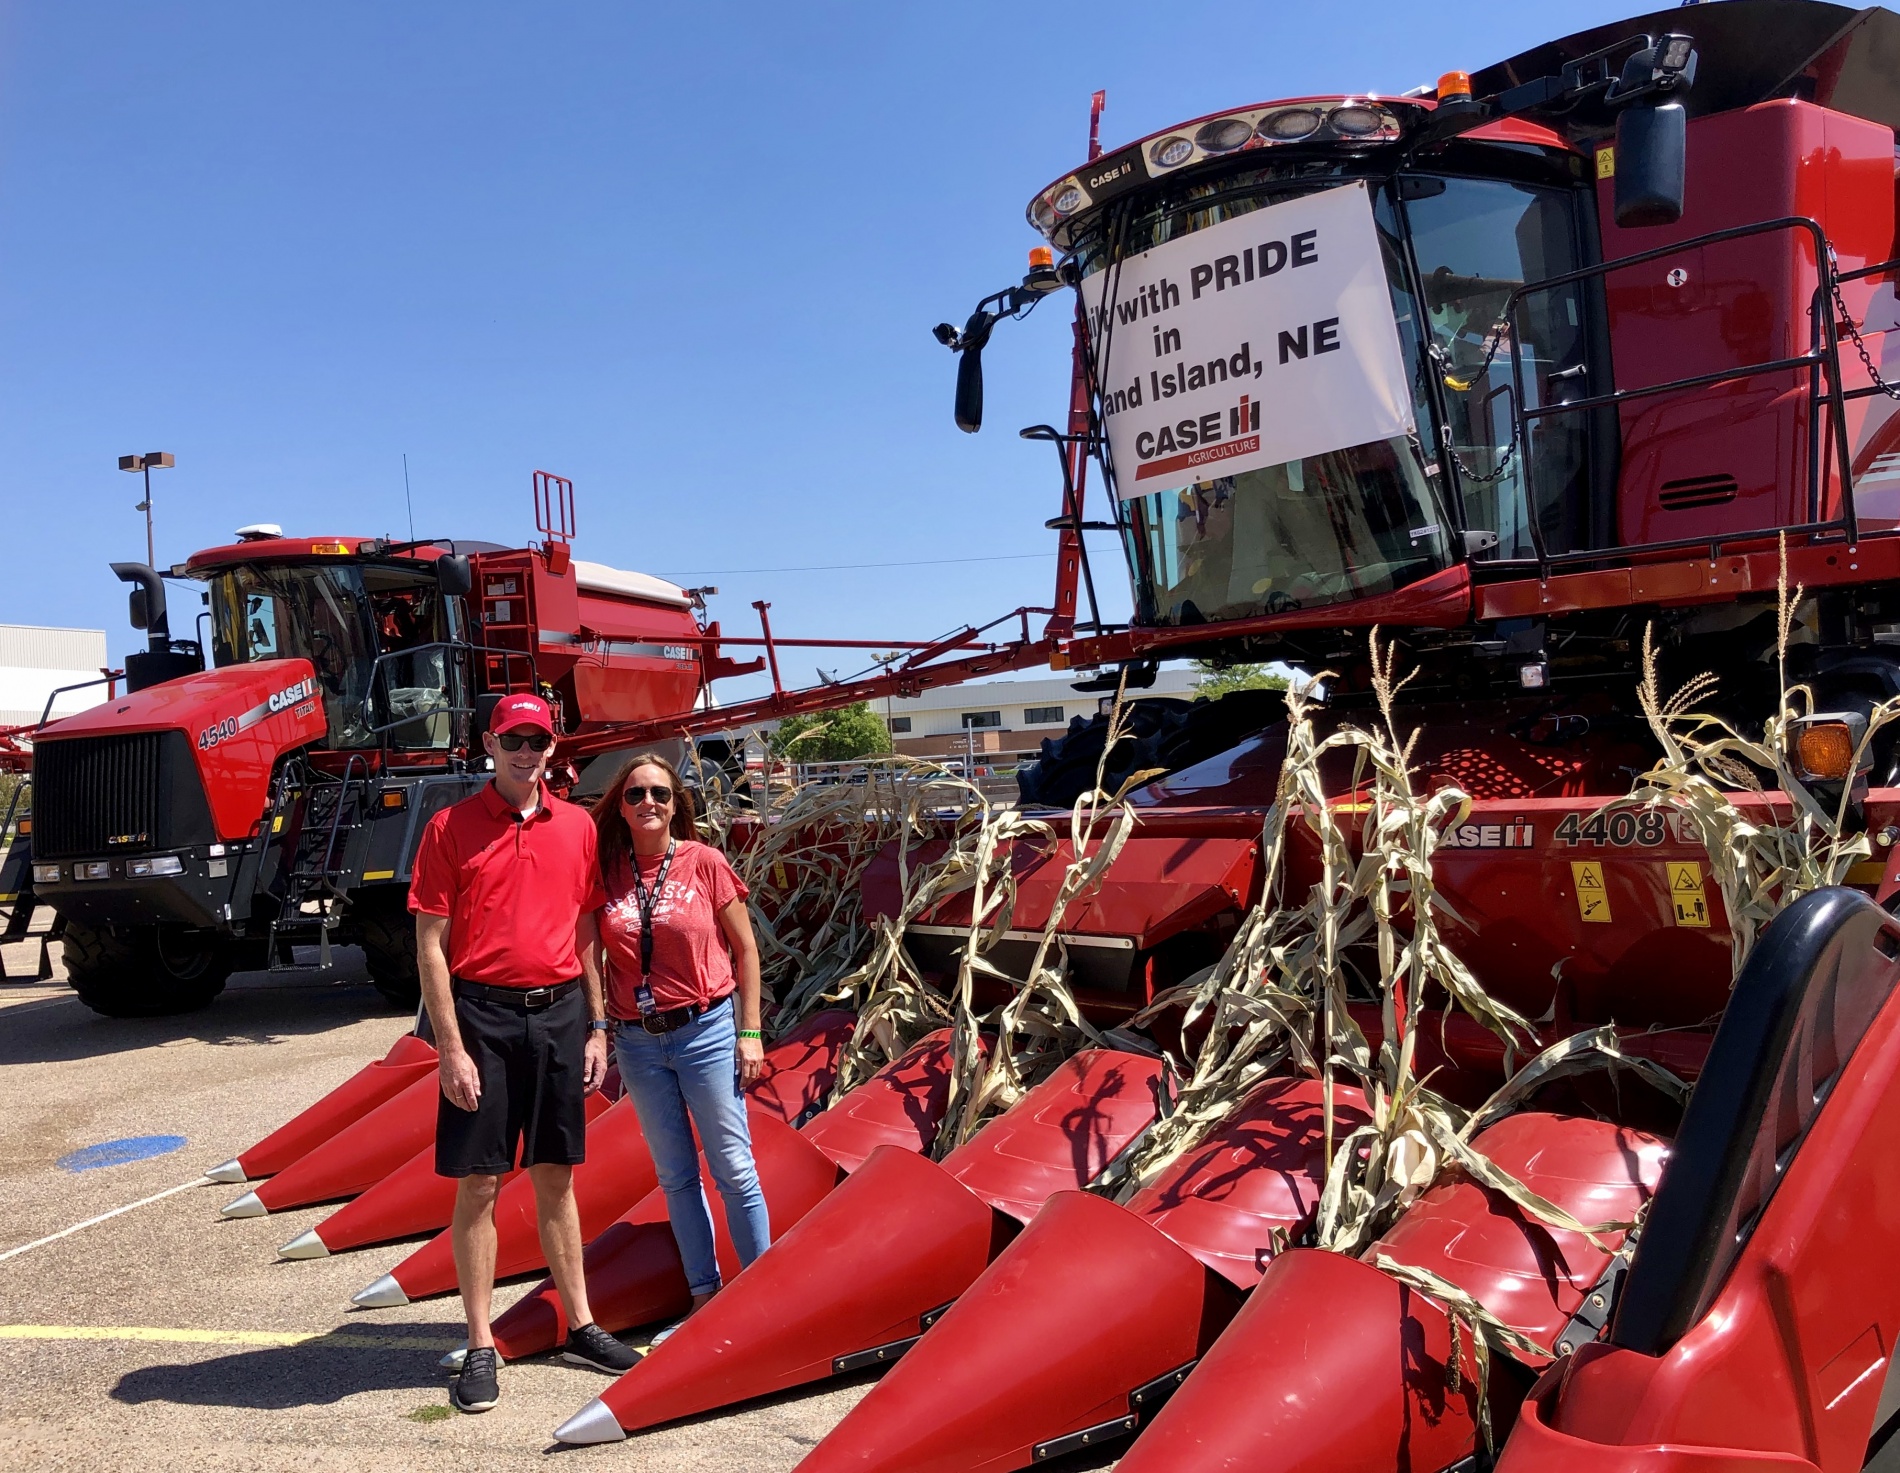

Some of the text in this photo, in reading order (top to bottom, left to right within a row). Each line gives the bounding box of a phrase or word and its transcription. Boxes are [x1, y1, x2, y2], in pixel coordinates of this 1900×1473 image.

[1090, 168, 1120, 188] CASE
[1116, 278, 1180, 326] with
[1190, 229, 1318, 300] PRIDE
[1153, 325, 1181, 358] in
[1150, 342, 1263, 402] Island,
[1278, 317, 1340, 366] NE
[1135, 412, 1221, 460] CASE
[1187, 439, 1257, 466] AGRICULTURE
[663, 645, 686, 660] CASE
[268, 683, 303, 712] CASE
[198, 716, 237, 751] 4540
[109, 835, 136, 844] CASE
[1435, 825, 1501, 847] ASE
[1554, 811, 1665, 847] 4408
